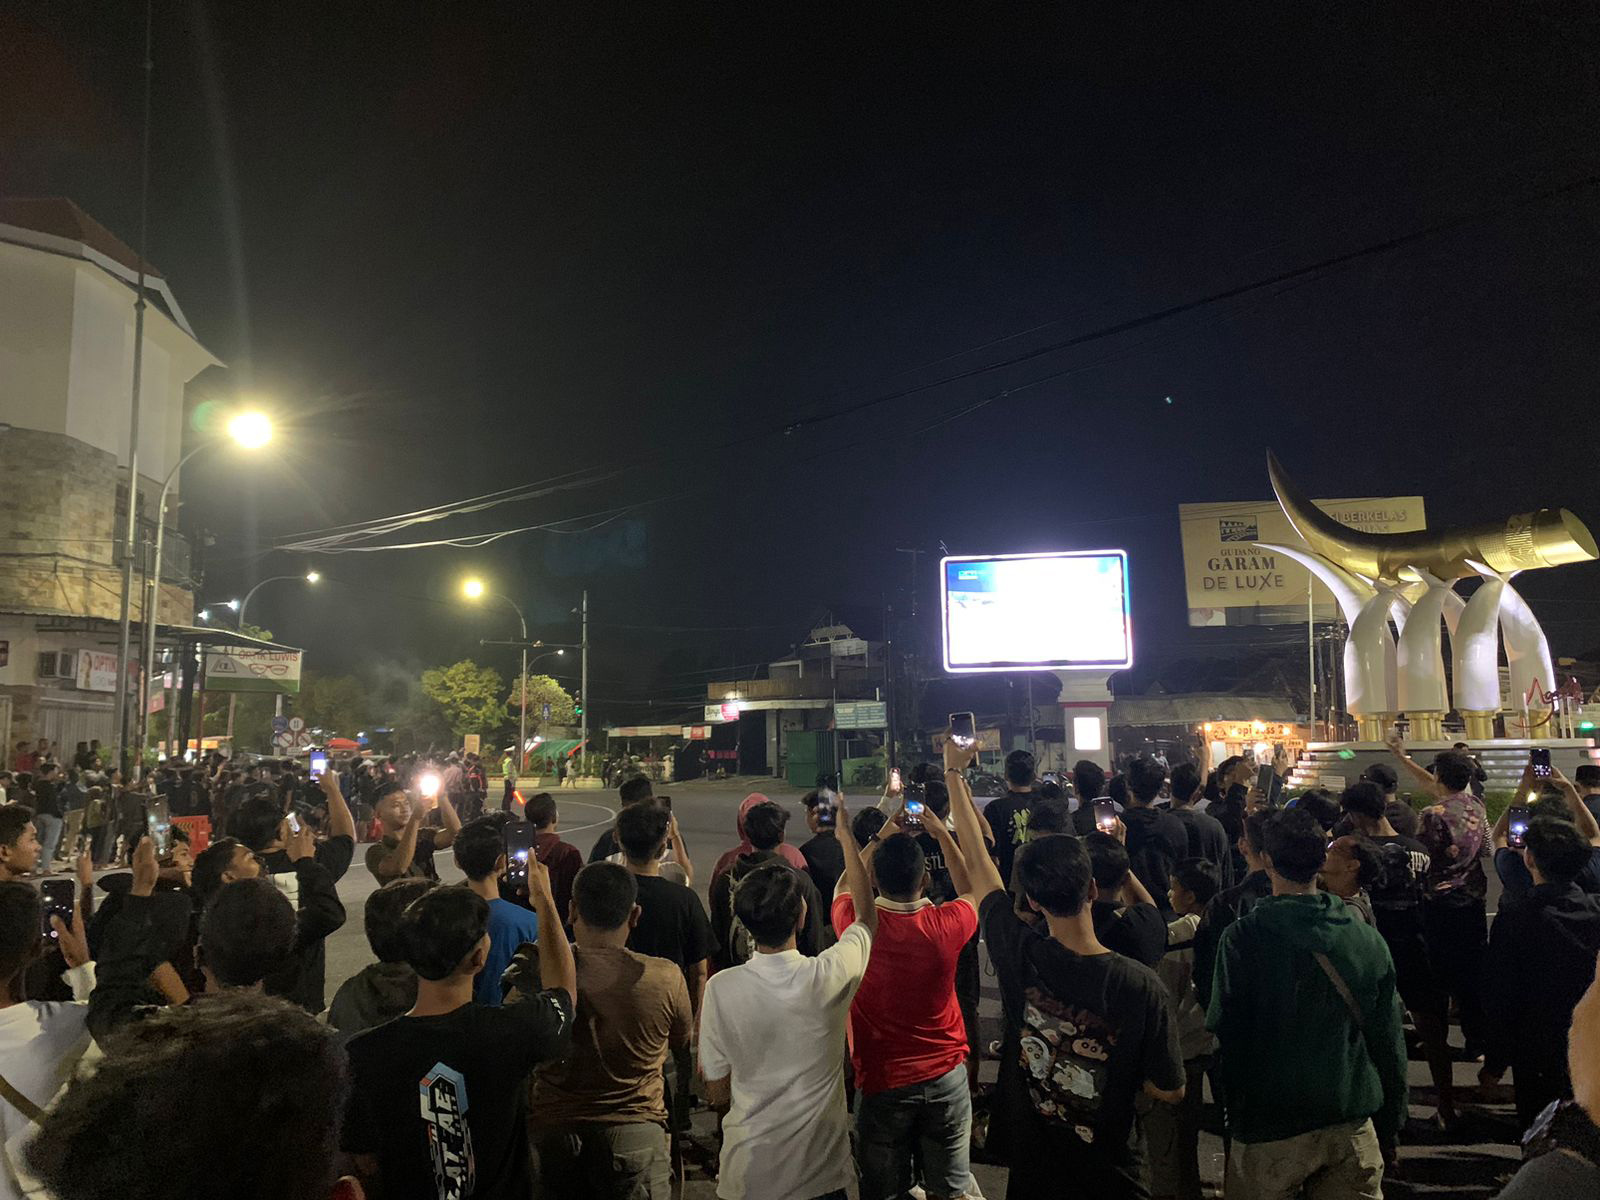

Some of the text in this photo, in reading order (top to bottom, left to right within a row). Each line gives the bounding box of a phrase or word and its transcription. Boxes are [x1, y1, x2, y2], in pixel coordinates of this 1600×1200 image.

[1343, 510, 1407, 522] BERKELAS
[1220, 548, 1261, 556] GUDANG
[1207, 557, 1276, 571] GARAM
[1203, 572, 1284, 590] DE LUXE
